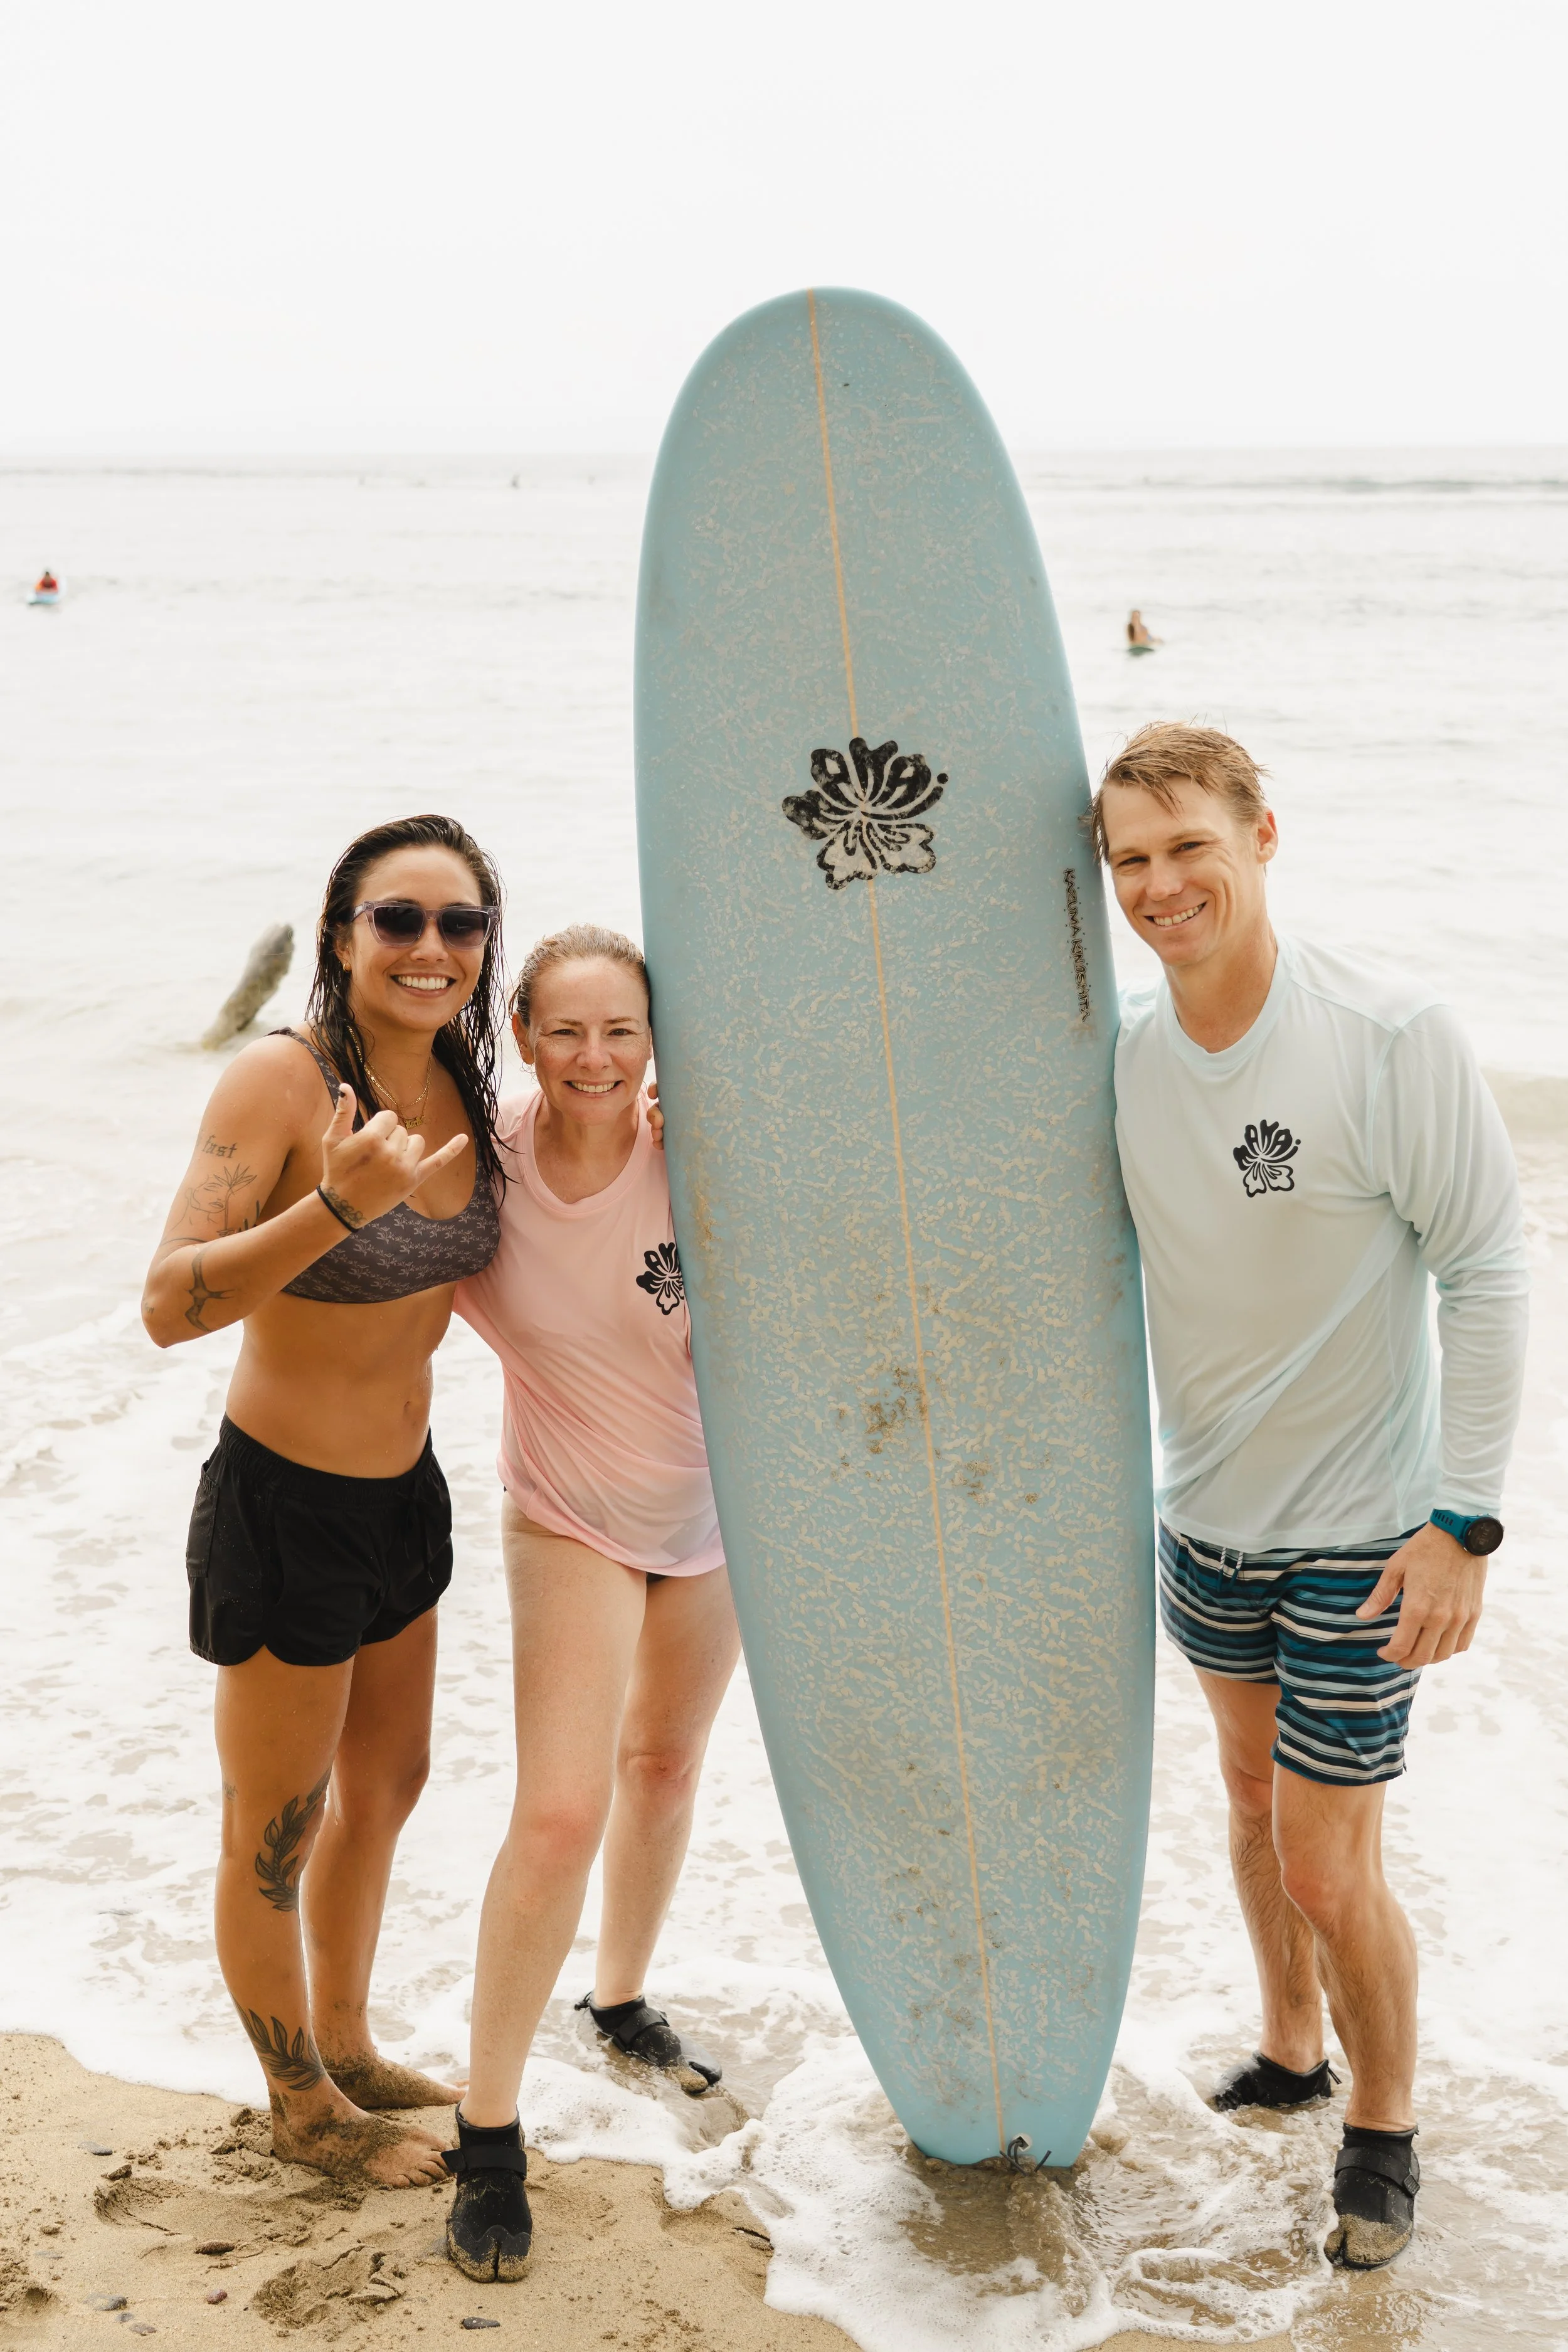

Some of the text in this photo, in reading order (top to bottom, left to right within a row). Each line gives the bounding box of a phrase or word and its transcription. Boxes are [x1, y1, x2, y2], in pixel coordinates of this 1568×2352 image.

[1062, 867, 1082, 938] KAZUMA
[1070, 938, 1091, 1023] KINOSHITA
[201, 1133, 238, 1158] fast
